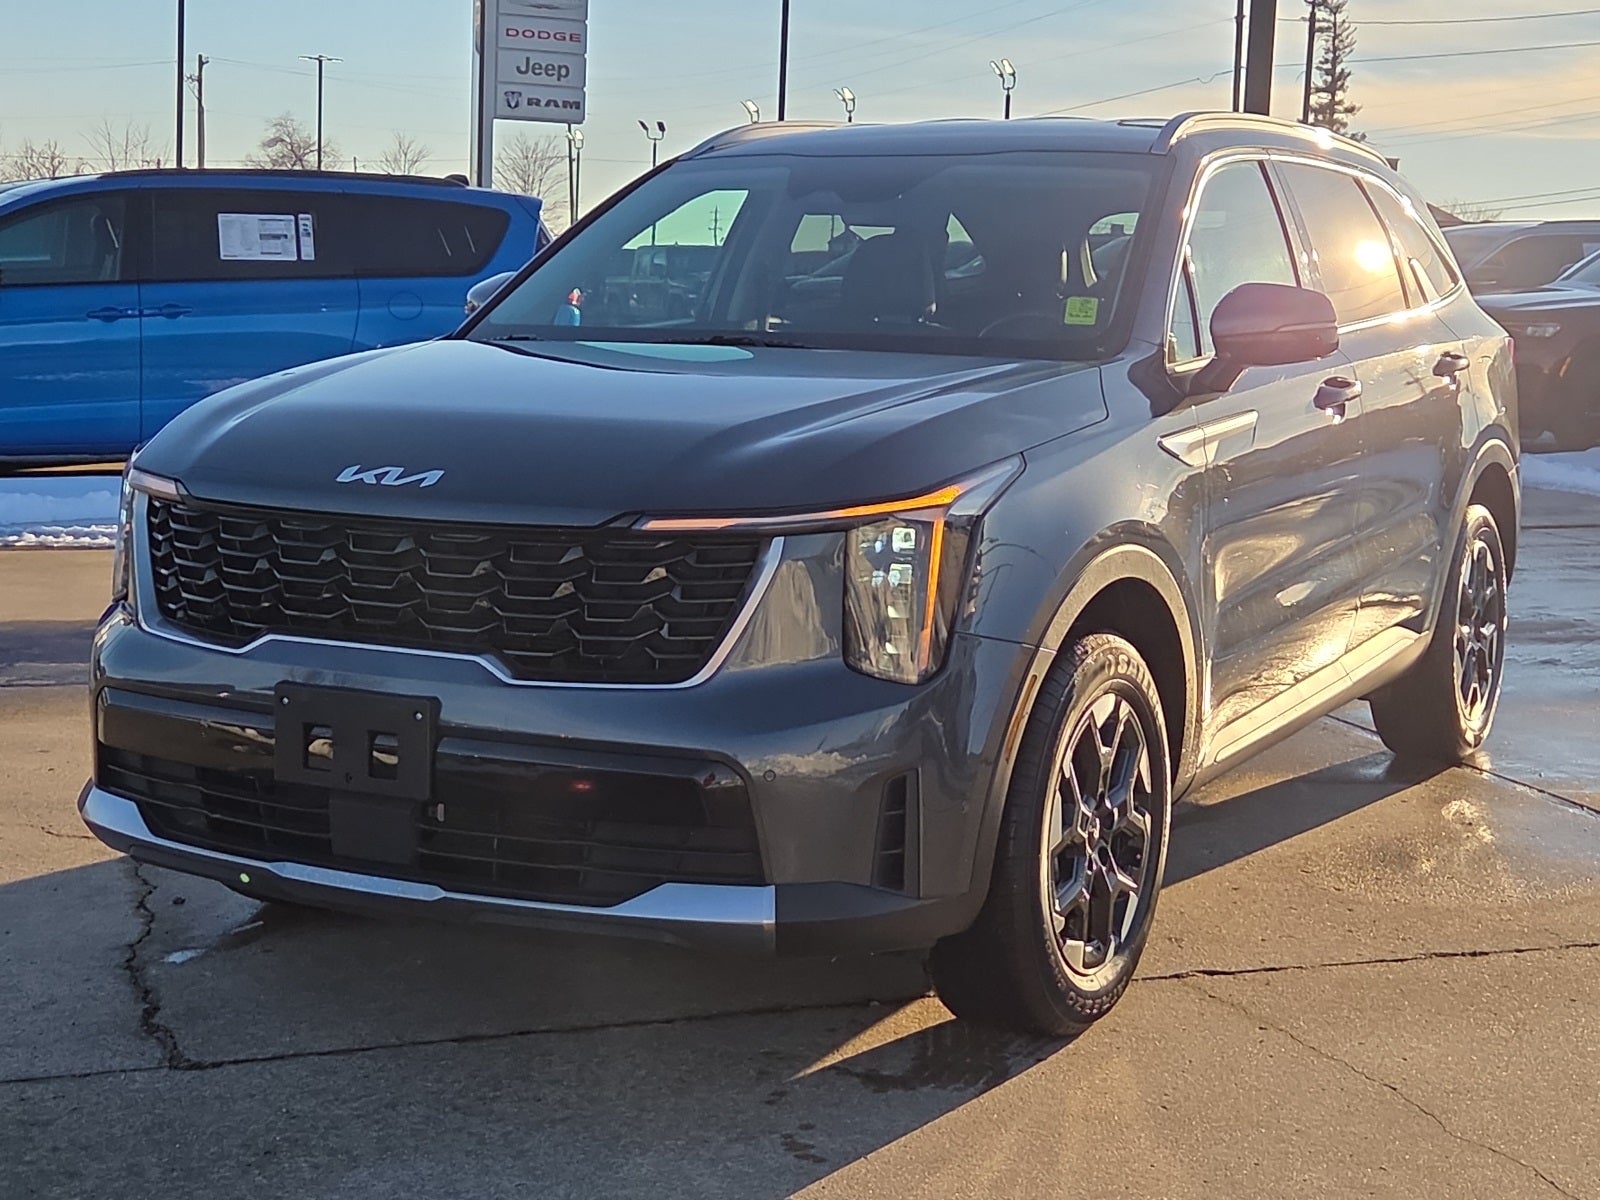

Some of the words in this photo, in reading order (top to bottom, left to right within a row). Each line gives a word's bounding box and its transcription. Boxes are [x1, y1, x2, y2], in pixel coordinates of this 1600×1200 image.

[505, 27, 582, 43] DODGE
[516, 56, 570, 81] Jeep
[526, 96, 581, 110] RAM
[336, 464, 445, 488] KIA
